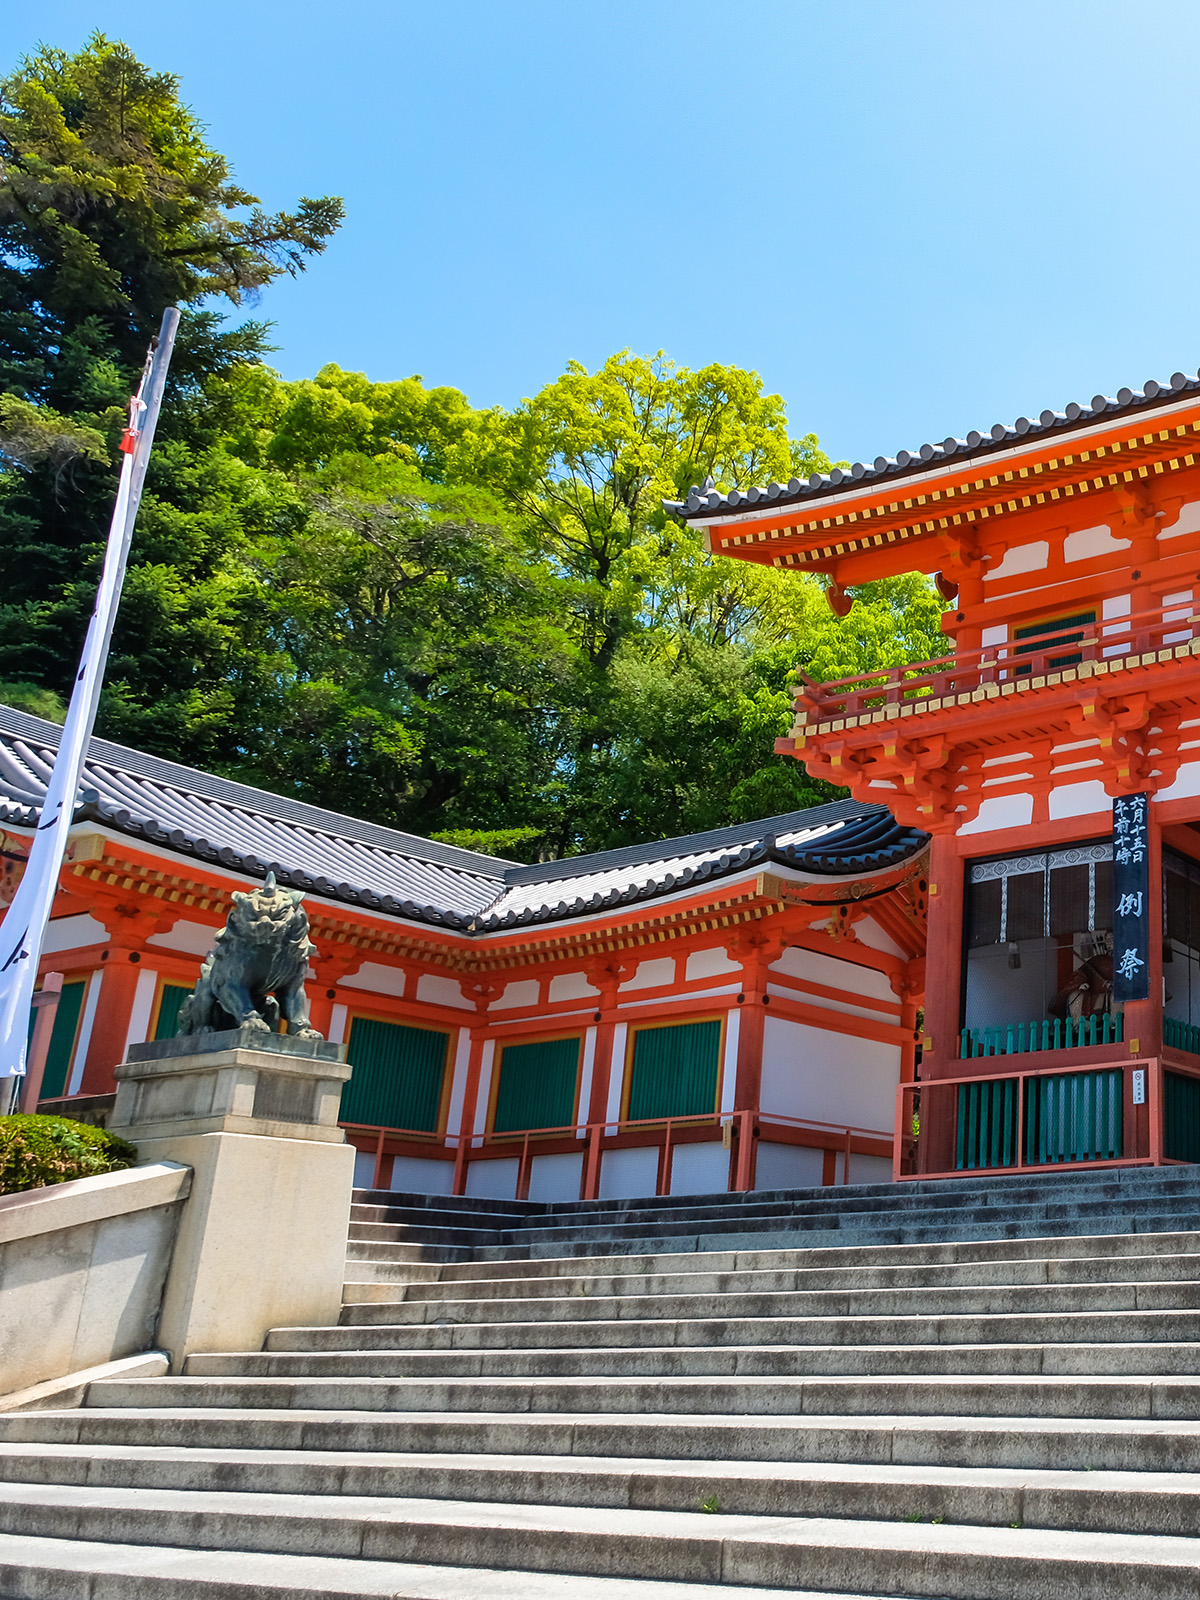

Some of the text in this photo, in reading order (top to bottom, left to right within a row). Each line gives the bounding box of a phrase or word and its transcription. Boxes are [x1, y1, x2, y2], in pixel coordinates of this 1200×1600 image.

[1115, 800, 1130, 865] 午前十時
[1131, 797, 1146, 864] 六月十五日
[1115, 892, 1145, 980] 例祭
